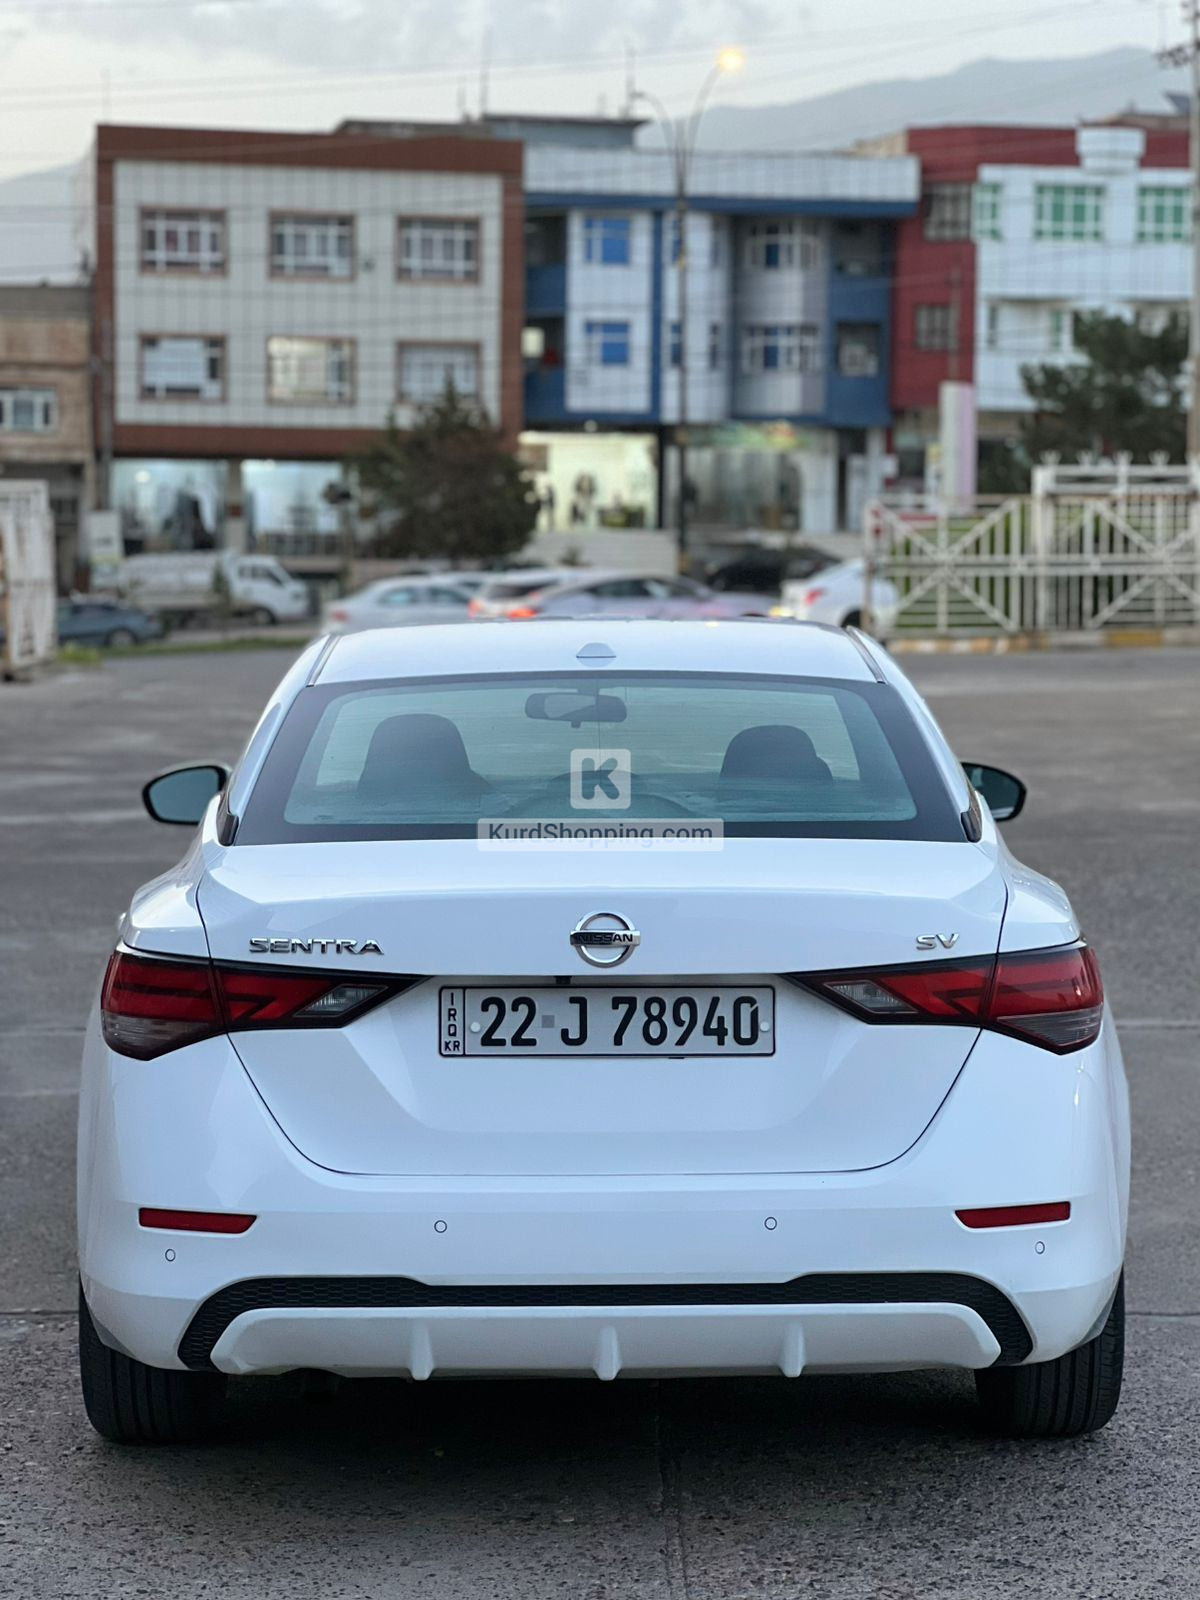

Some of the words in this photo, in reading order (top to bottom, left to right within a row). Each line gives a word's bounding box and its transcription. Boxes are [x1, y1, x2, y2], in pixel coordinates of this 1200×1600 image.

[249, 937, 385, 955] SENTRA
[576, 933, 633, 944] NISSAN
[916, 933, 959, 950] SV
[480, 996, 538, 1047] 22
[560, 996, 588, 1047] J
[611, 996, 760, 1047] 78940
[444, 1040, 461, 1052] KR
